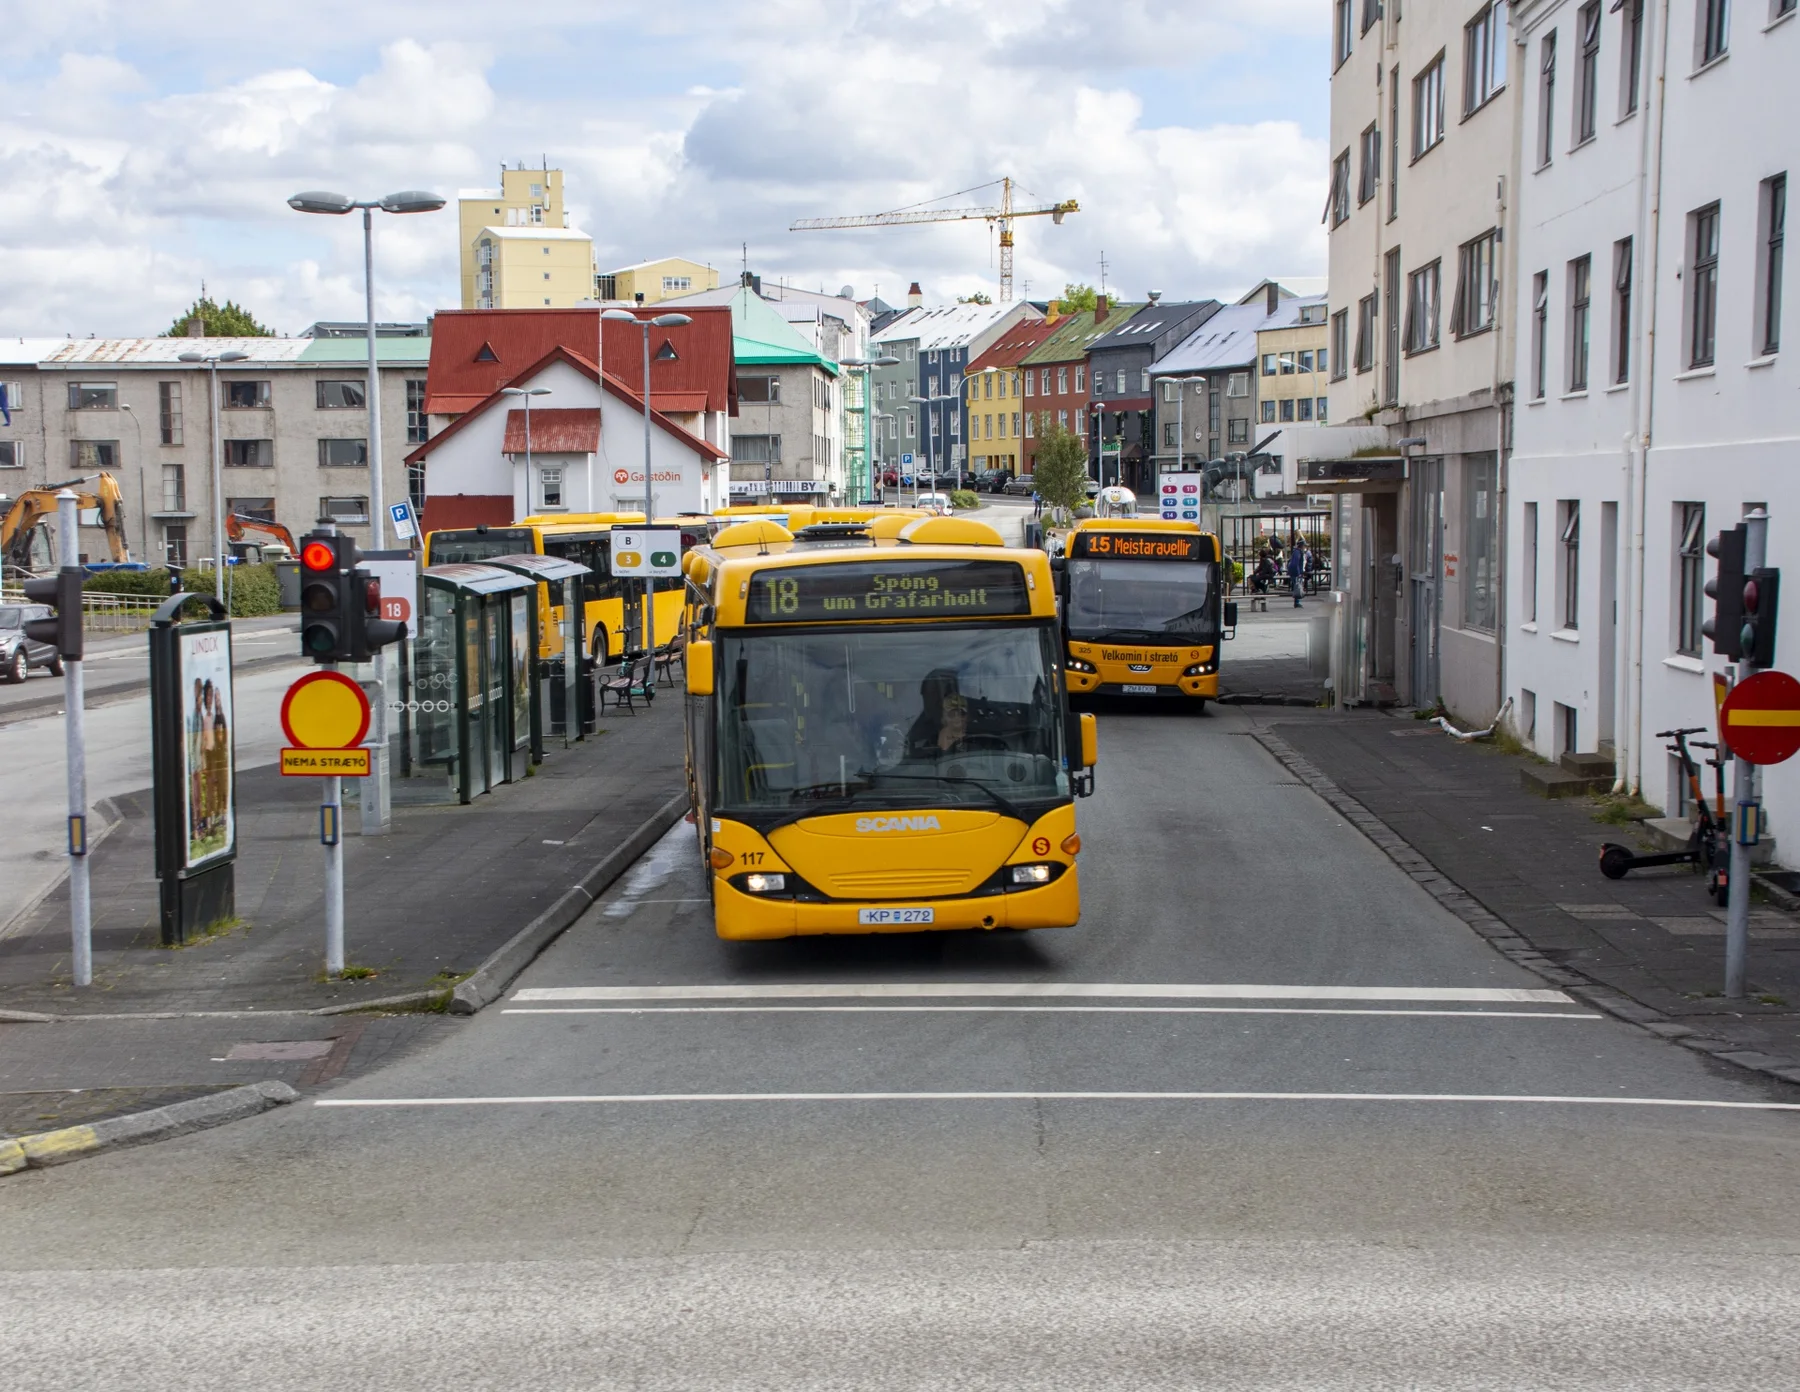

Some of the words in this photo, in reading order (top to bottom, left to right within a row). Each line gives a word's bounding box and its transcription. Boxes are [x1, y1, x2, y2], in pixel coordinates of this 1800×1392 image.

[1318, 466, 1325, 476] 5
[801, 482, 817, 492] BY
[395, 507, 404, 519] P
[625, 536, 632, 546] B
[1089, 536, 1110, 552] 15
[1114, 539, 1191, 556] Meistaravellir
[625, 555, 632, 564] 3
[660, 555, 667, 564] 4
[873, 573, 939, 593] Spöng
[766, 577, 799, 614] 18
[823, 596, 856, 610] um
[864, 588, 988, 609] Grafarholt
[386, 603, 402, 618] 18
[1101, 649, 1142, 662] Velkomin
[1144, 650, 1148, 662] í
[1149, 650, 1178, 663] strætó
[284, 757, 318, 767] NEMA
[320, 756, 367, 767] STRÆTÓ
[856, 815, 941, 833] SCANIA
[740, 851, 765, 866] 117
[868, 910, 890, 922] KP
[903, 910, 931, 922] 272
